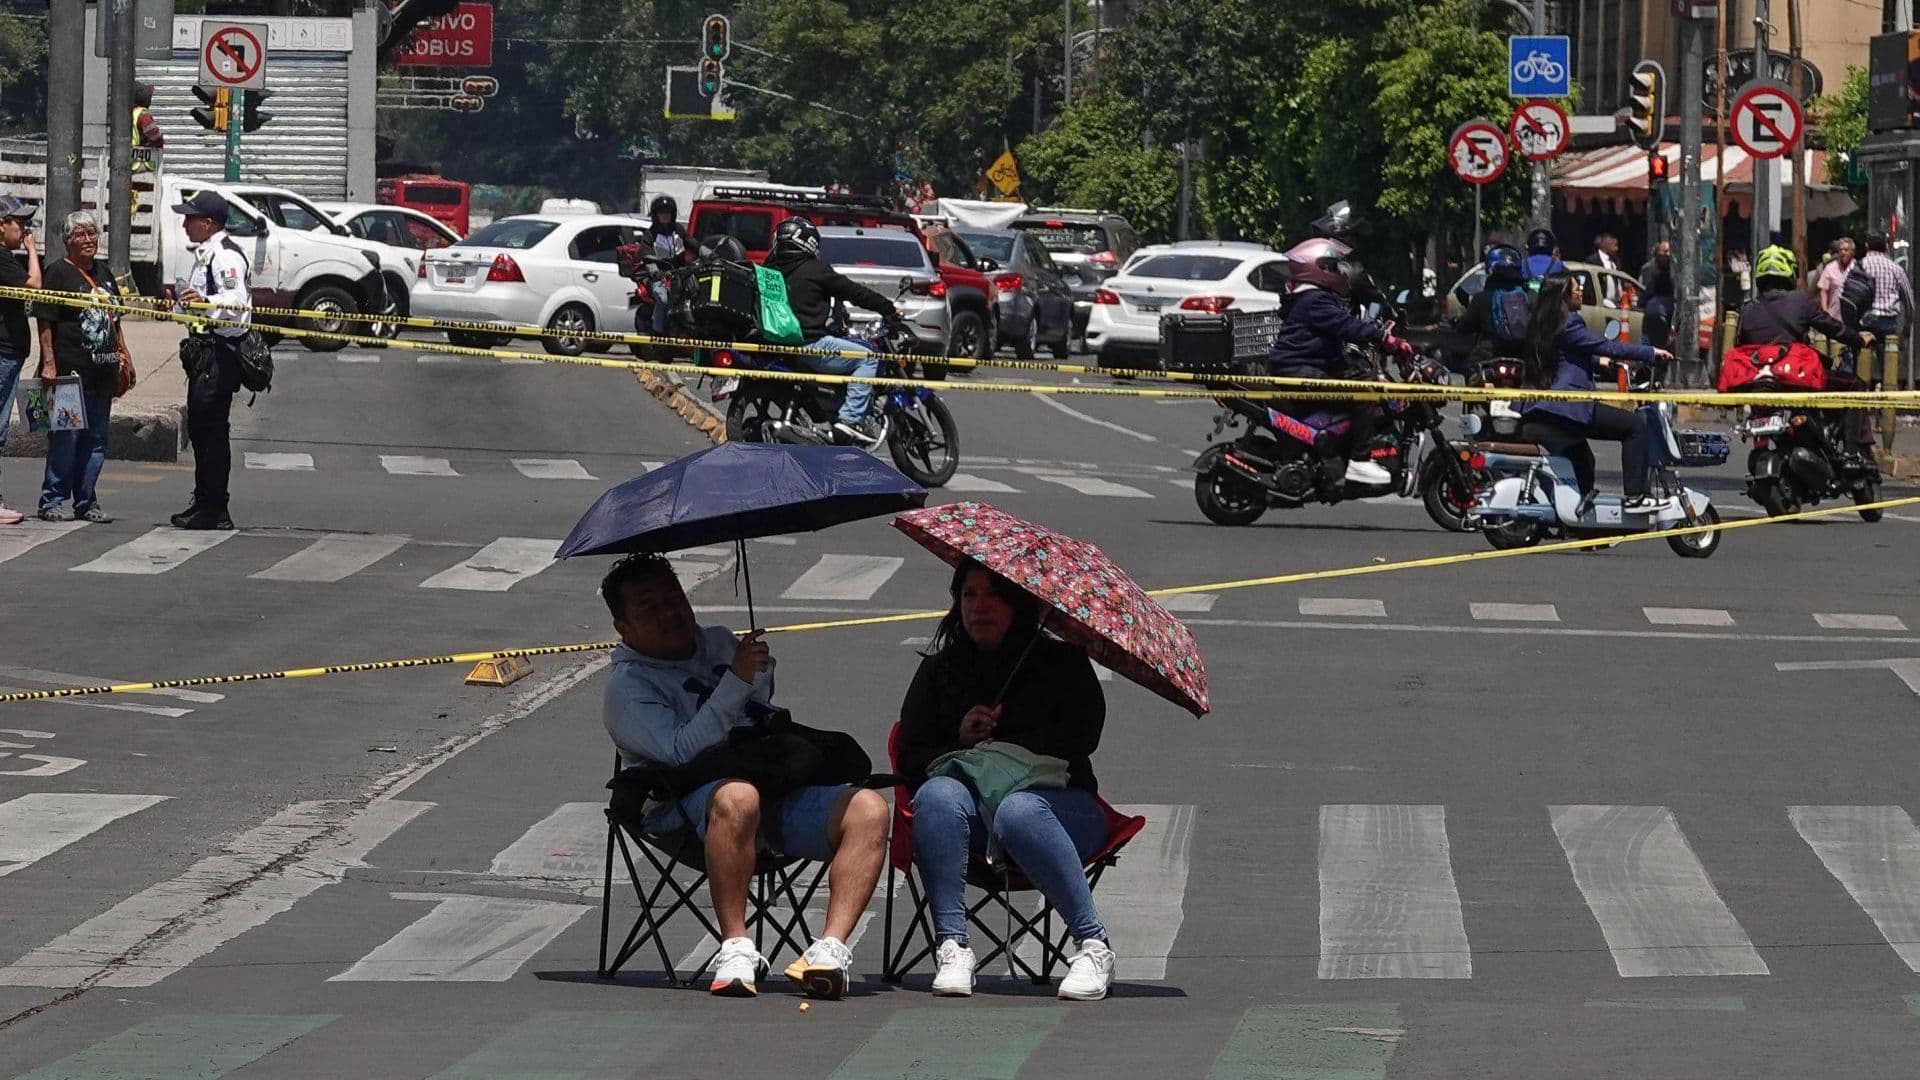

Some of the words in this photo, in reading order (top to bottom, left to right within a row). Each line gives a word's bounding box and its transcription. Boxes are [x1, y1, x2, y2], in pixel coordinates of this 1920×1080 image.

[415, 40, 474, 56] OBUS
[433, 320, 517, 333] PRECAUCION
[541, 328, 624, 341] PRECAUCION
[650, 335, 733, 349] PRECAUCION
[758, 343, 841, 356] PRECAUCION
[976, 359, 1059, 371] PRECAUCION
[1084, 366, 1168, 378] PRECAUCION
